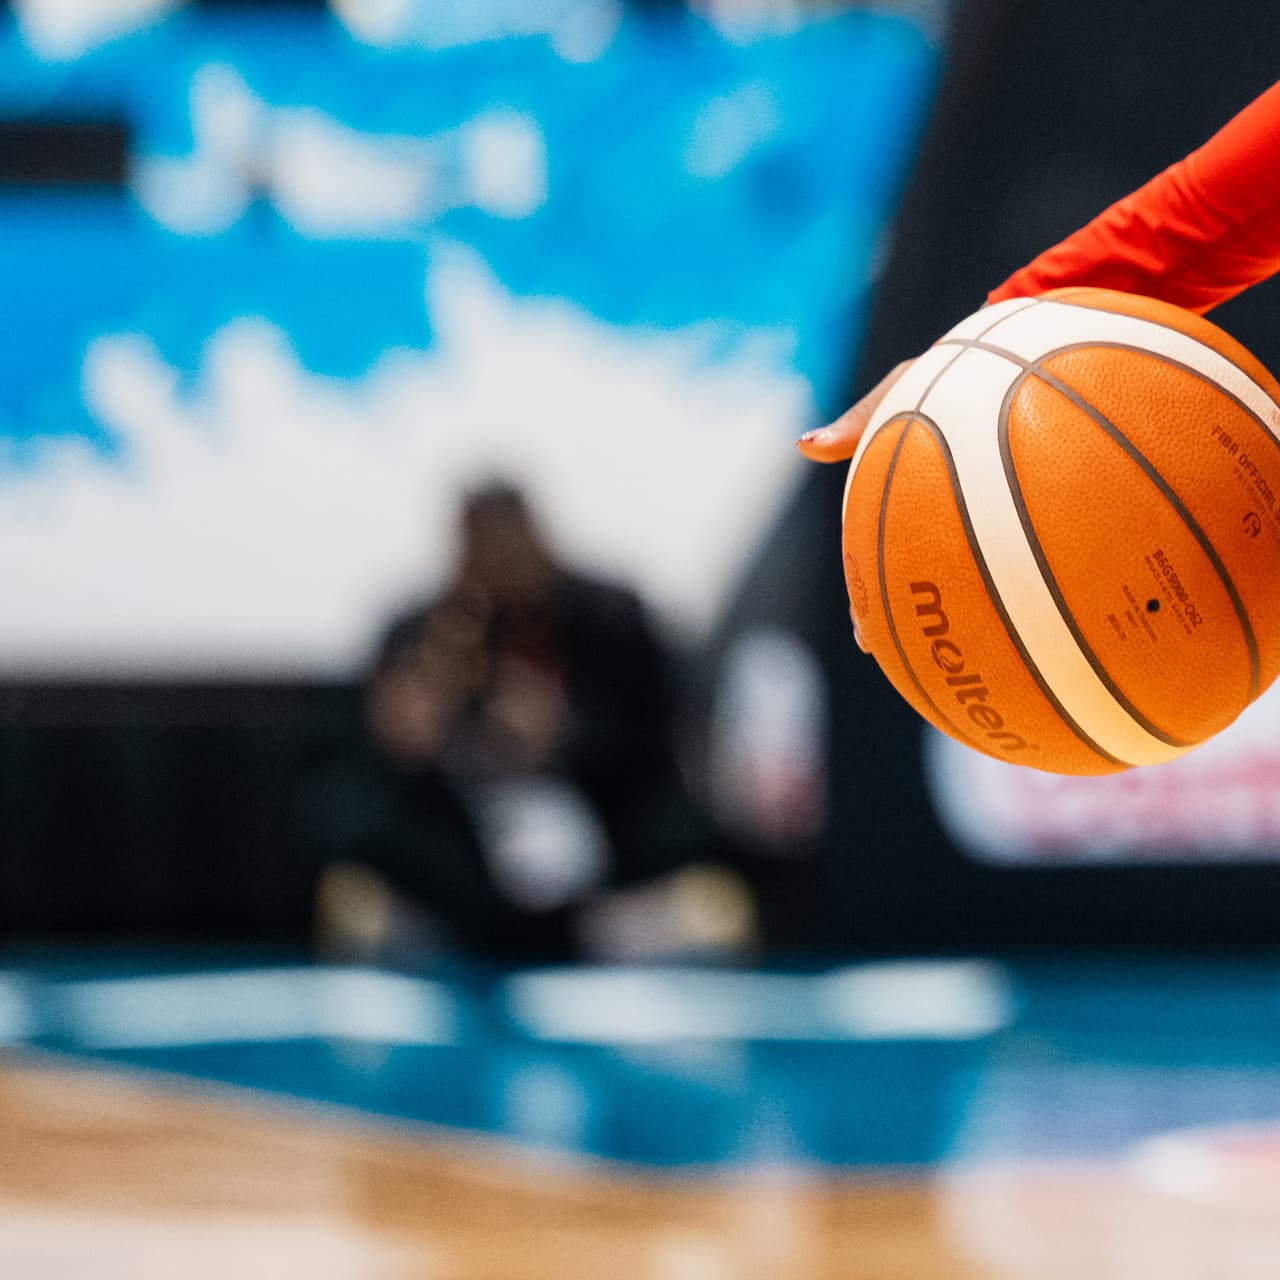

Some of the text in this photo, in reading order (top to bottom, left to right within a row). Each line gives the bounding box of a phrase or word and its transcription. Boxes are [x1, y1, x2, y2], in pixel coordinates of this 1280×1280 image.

[1211, 425, 1240, 456] FIBA
[1238, 453, 1277, 512] OFFICIAL
[910, 581, 1028, 751] molten
